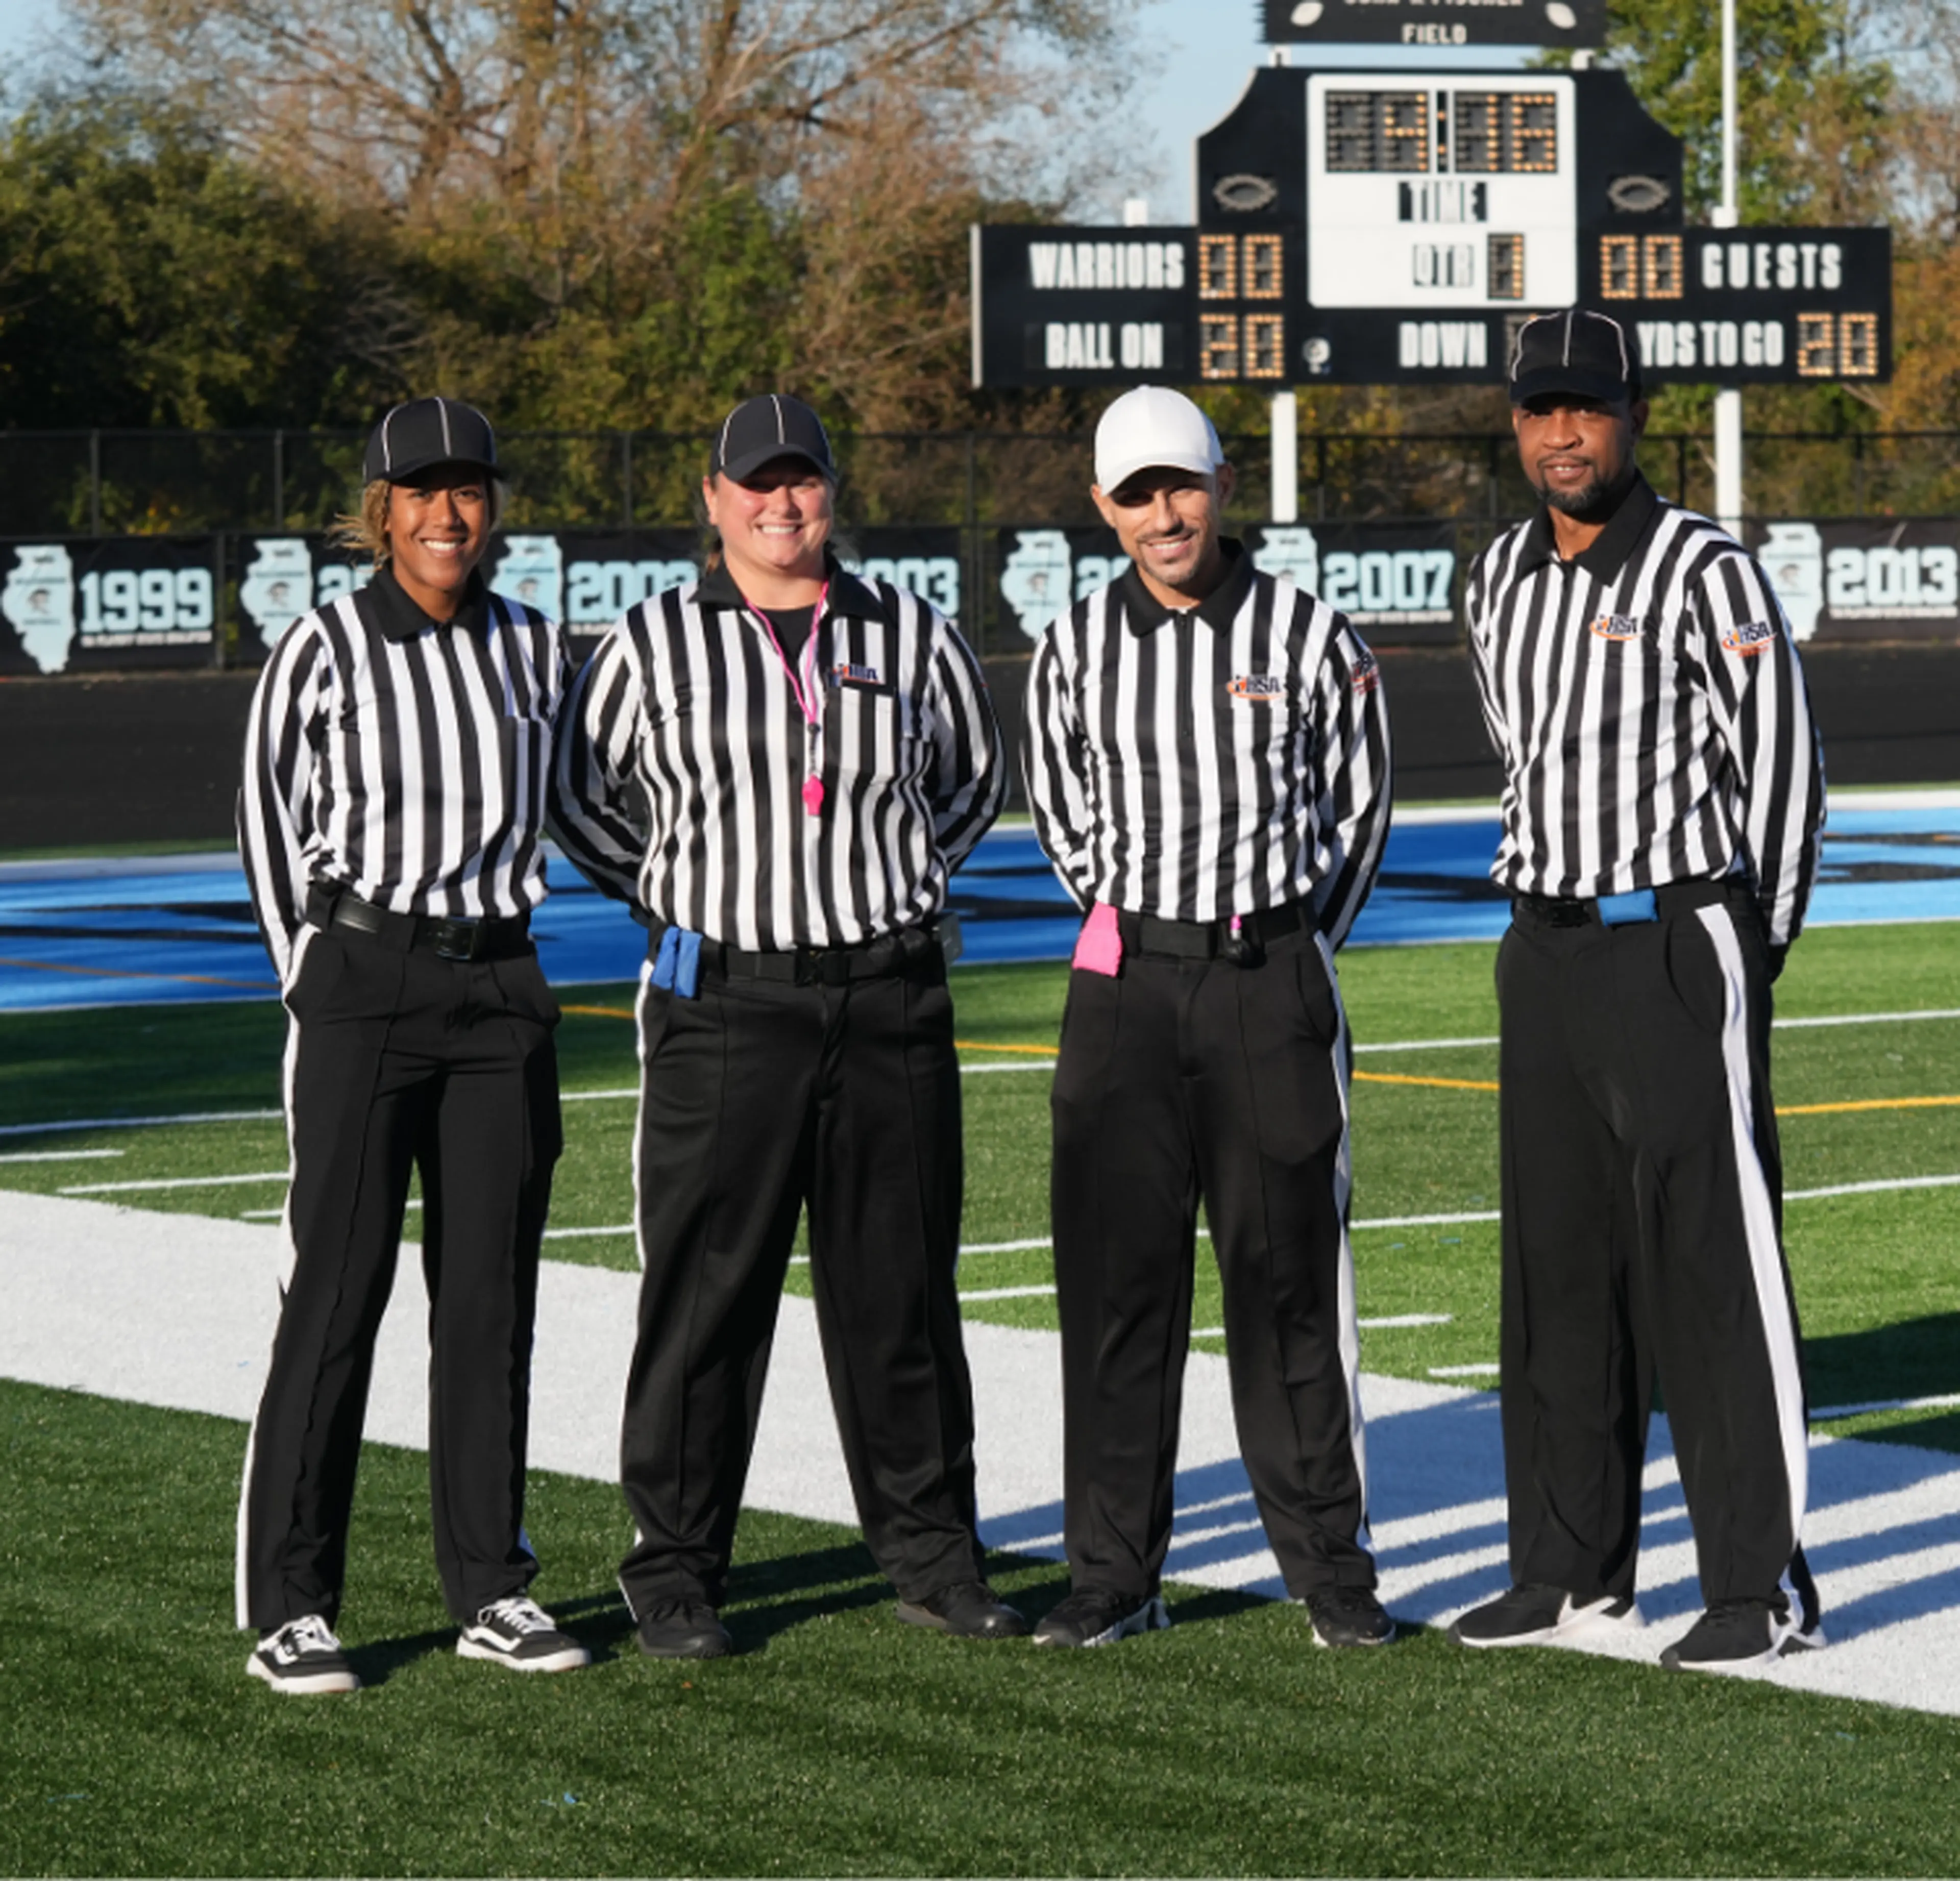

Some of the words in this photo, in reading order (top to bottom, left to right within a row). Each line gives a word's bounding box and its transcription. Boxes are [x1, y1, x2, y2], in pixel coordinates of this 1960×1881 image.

[1402, 23, 1467, 45] FIELD
[1407, 181, 1479, 221] TIME
[1029, 242, 1184, 289] WARRIORS
[1199, 234, 1282, 299] 00
[1414, 244, 1474, 287] QTR
[1601, 235, 1682, 299] 00
[1702, 243, 1842, 289] GUESTS
[1045, 323, 1114, 369] BALL
[1120, 323, 1164, 369] ON
[1199, 313, 1284, 379] 20
[1399, 321, 1487, 367] DOWN
[1636, 321, 1696, 367] YDS
[1700, 321, 1737, 367] TO
[1742, 320, 1784, 366] GO
[1796, 312, 1878, 377] 20
[80, 567, 213, 633] 1999
[841, 557, 959, 617] 03
[1324, 550, 1454, 610] 2007
[1827, 547, 1958, 605] 2013
